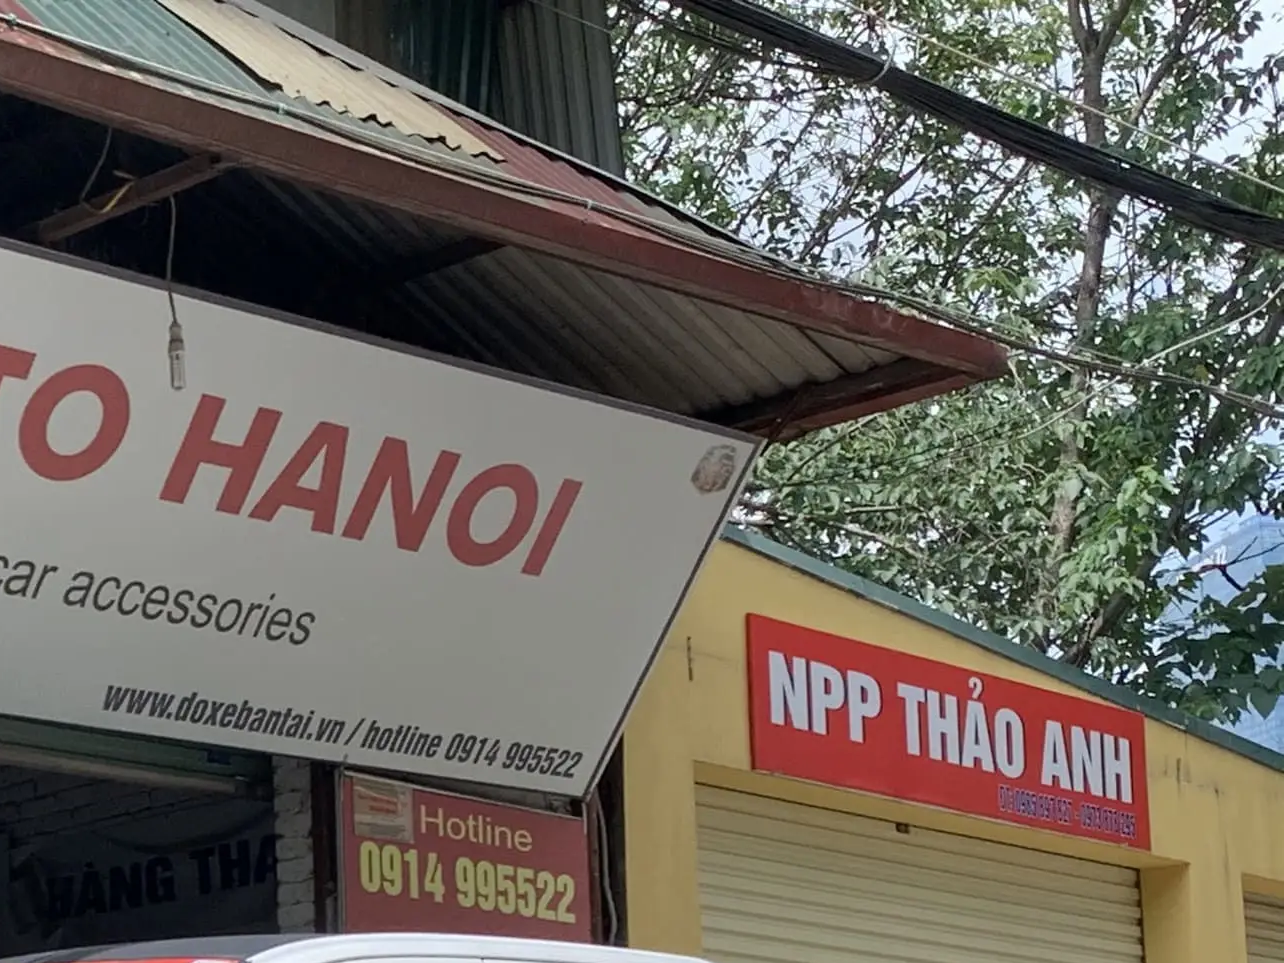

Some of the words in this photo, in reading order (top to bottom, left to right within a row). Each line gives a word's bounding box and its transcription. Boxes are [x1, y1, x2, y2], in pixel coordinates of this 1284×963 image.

[159, 393, 582, 576] HANOI
[63, 569, 316, 647] accessories
[101, 683, 347, 745] www.doxebantai.vn
[343, 717, 365, 747] /
[360, 719, 442, 759] hotline
[443, 732, 501, 768] 0914
[502, 740, 584, 779] 995522
[768, 649, 882, 744] NPP
[897, 676, 1026, 779] THẢO
[1041, 718, 1134, 804] ANH
[419, 804, 533, 852] Hotline
[47, 861, 176, 923] HÀNG
[359, 840, 446, 903] 0914
[455, 856, 576, 924] 995522
